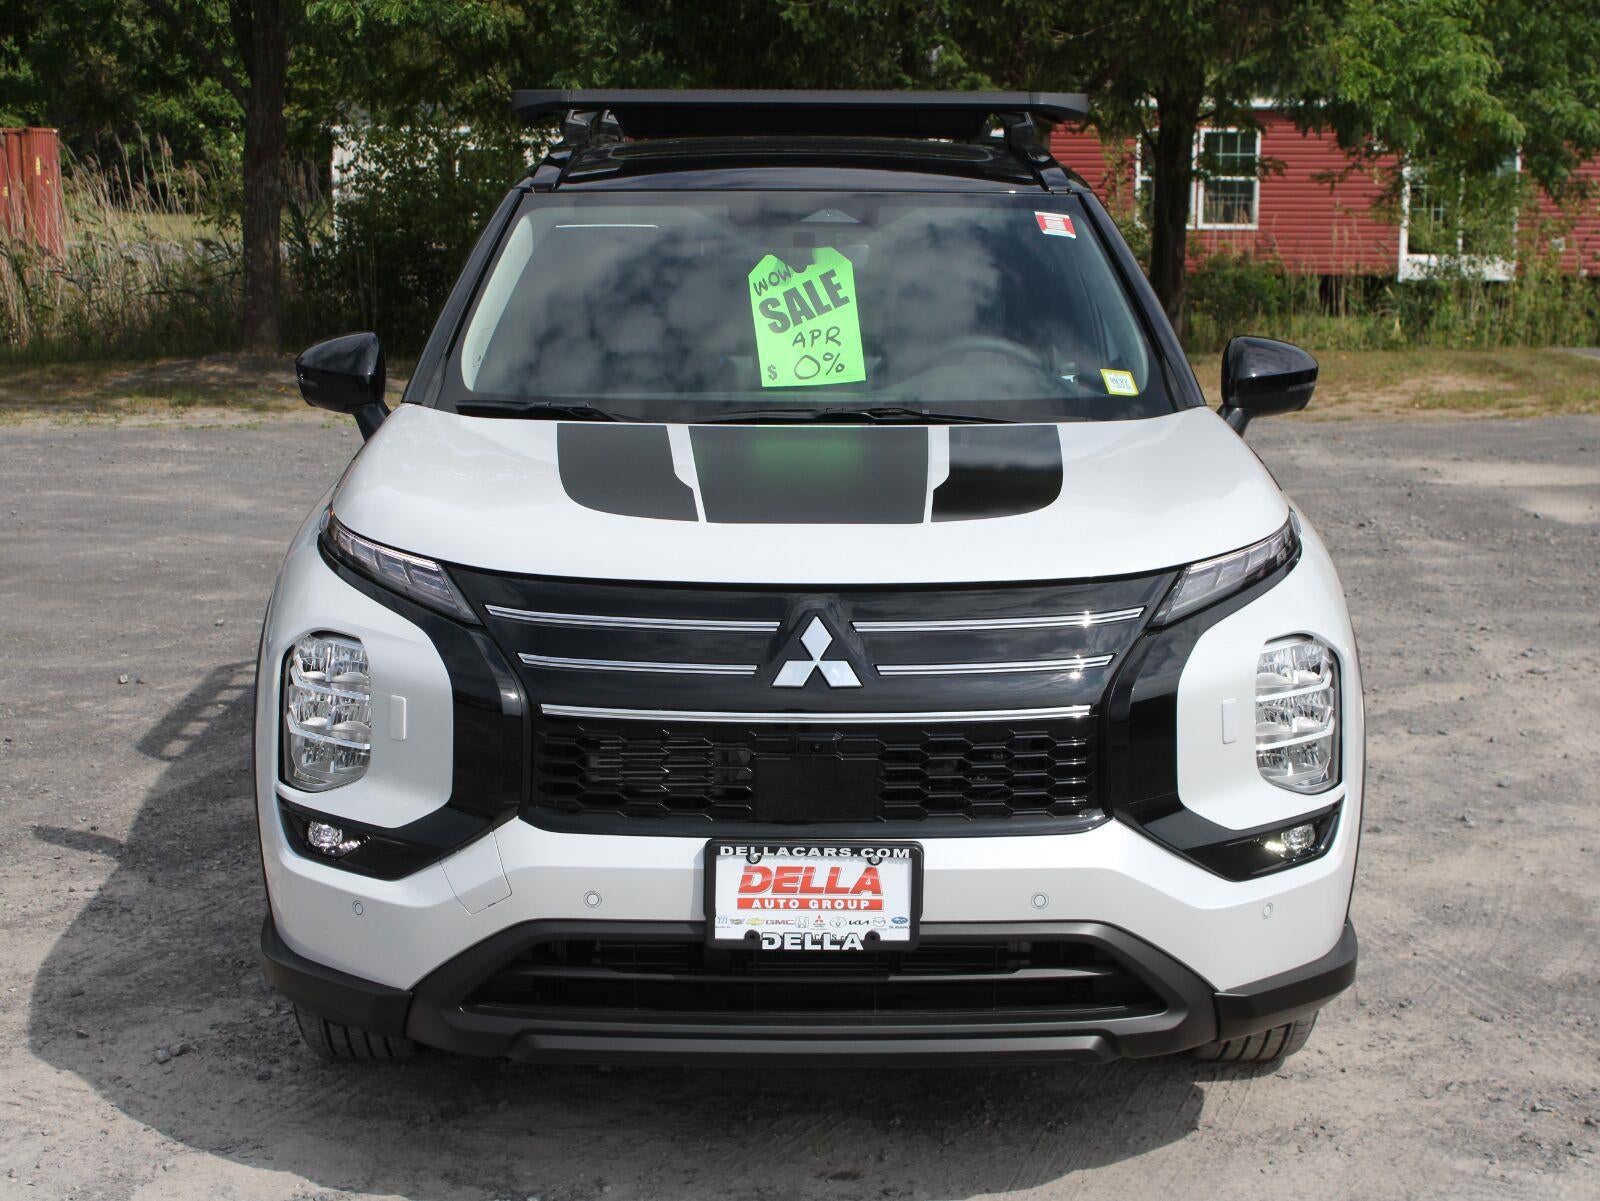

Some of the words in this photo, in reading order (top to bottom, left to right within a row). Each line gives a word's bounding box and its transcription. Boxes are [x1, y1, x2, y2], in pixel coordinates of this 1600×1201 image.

[753, 264, 793, 297] WOW
[758, 268, 851, 334] SALE
[792, 326, 842, 348] APR
[767, 364, 778, 381] $
[793, 352, 846, 380] 0%
[720, 846, 910, 859] DELLACARS.COM
[737, 865, 884, 896] DELLA
[751, 899, 800, 909] AUTO
[808, 899, 870, 910] GROUP
[761, 932, 864, 950] DELLA
